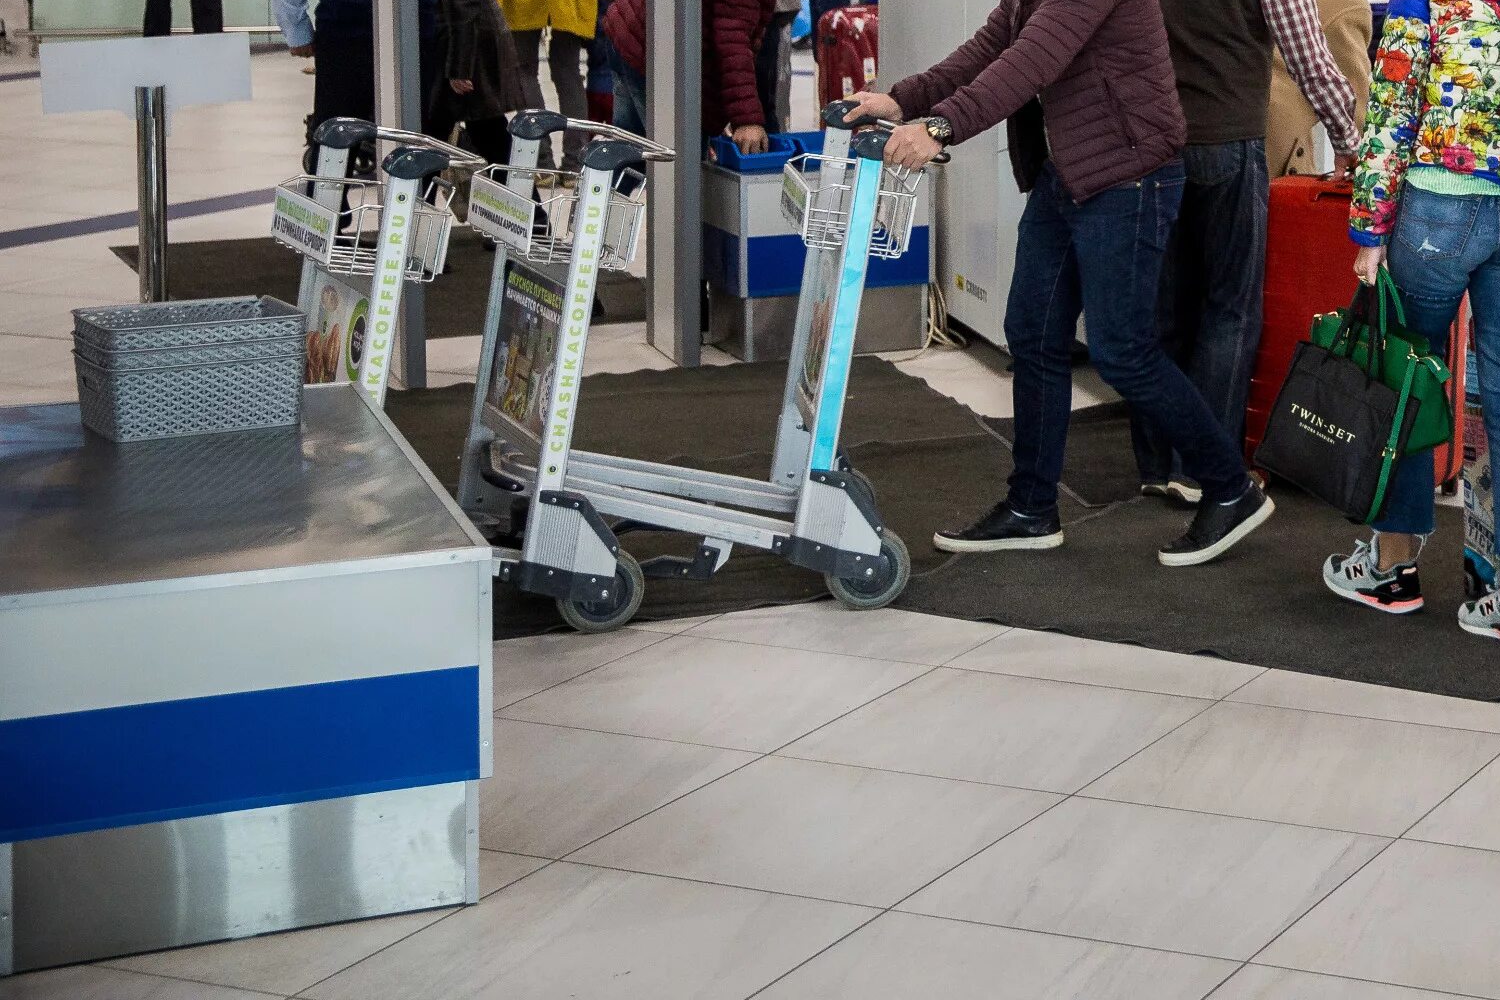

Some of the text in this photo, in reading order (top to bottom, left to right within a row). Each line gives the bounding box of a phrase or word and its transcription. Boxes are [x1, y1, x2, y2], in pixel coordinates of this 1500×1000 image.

[550, 206, 600, 451] CHASHKACOFFEE.RU
[1291, 403, 1355, 443] TWIN-SET
[1352, 563, 1364, 578] N
[1485, 600, 1494, 614] N
